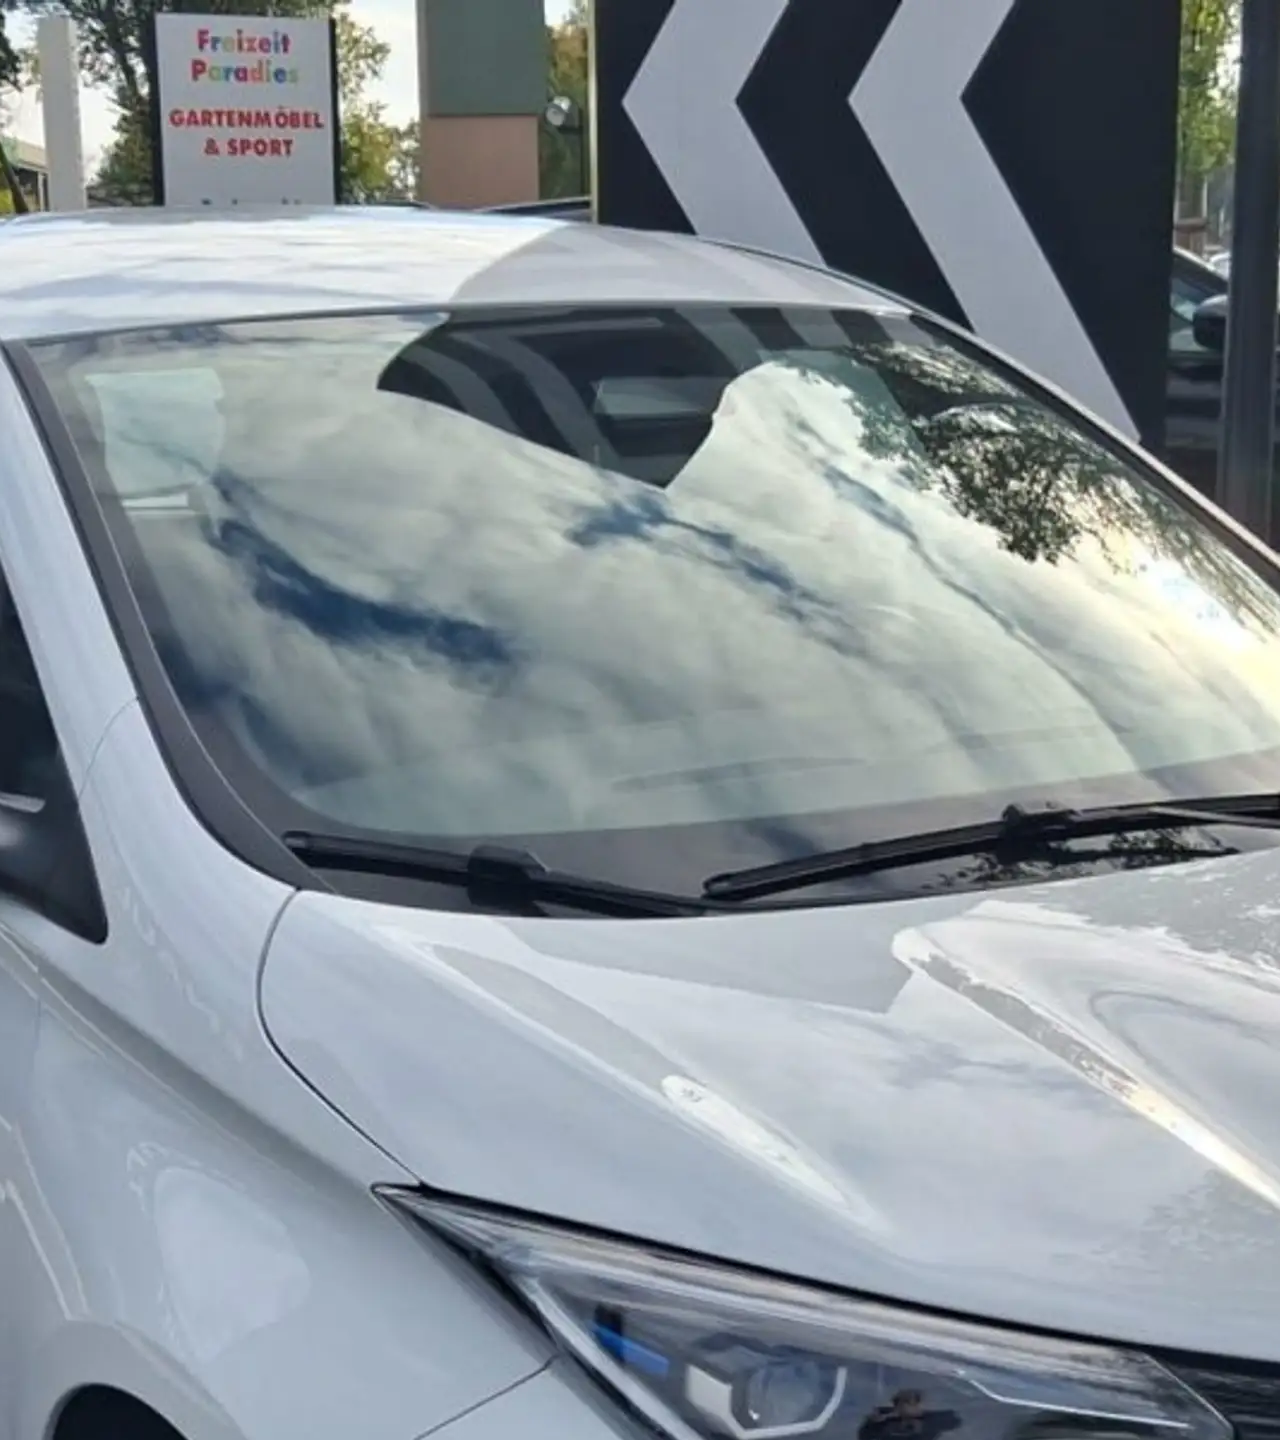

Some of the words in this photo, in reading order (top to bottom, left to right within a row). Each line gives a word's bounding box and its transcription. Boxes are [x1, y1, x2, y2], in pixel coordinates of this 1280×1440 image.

[197, 29, 290, 53] Freizeit
[191, 59, 298, 82] Paradies
[169, 105, 324, 129] GARTENMÖBEL
[204, 138, 219, 156] &
[227, 138, 293, 157] SPORT
